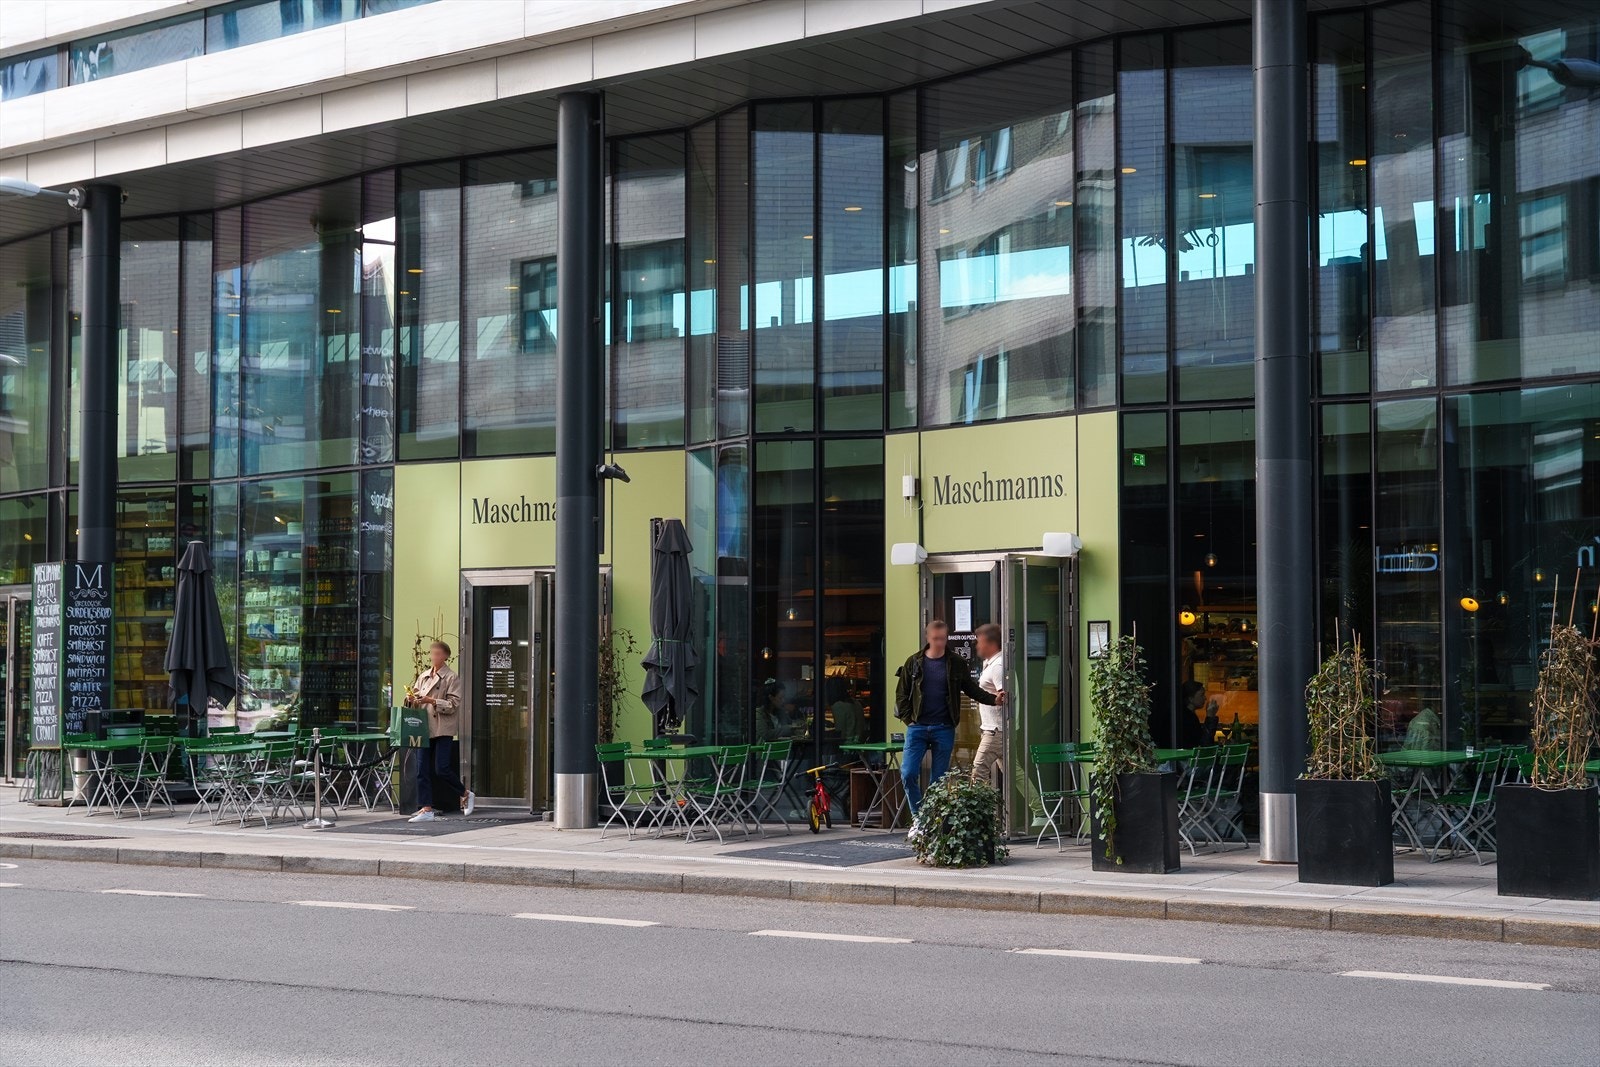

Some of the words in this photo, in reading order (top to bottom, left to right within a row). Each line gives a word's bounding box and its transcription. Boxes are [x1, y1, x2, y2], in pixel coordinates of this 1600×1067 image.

[932, 471, 1063, 506] Maschmanns
[75, 564, 103, 589] M
[69, 624, 107, 636] FROKOST
[67, 640, 105, 650] SMÅBAKST
[66, 653, 105, 664] SANDWICH
[66, 668, 105, 678] ANTIPASTI
[69, 681, 102, 692] SALATER
[36, 691, 54, 704] PIZZA
[71, 695, 101, 708] PIZZA
[408, 735, 422, 747] M
